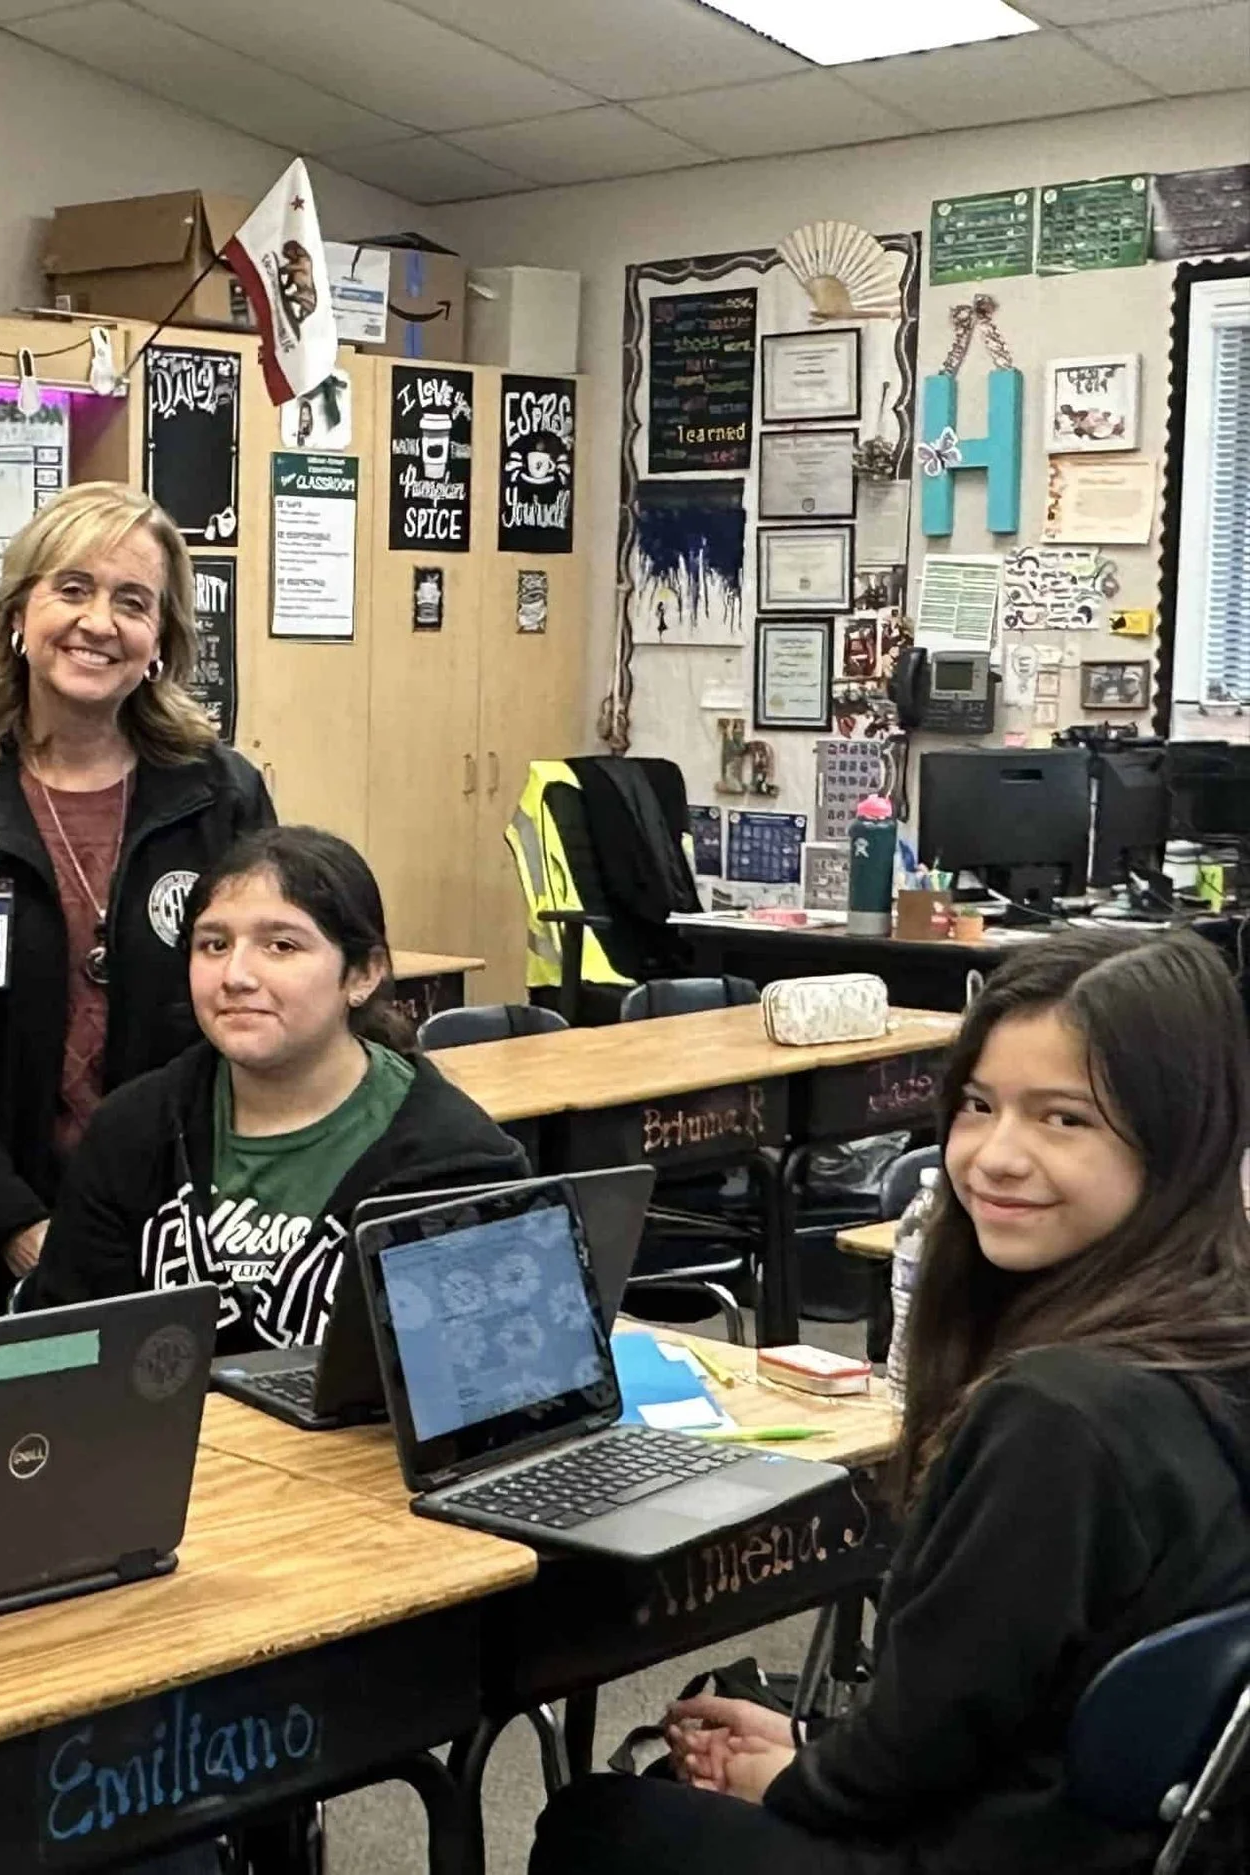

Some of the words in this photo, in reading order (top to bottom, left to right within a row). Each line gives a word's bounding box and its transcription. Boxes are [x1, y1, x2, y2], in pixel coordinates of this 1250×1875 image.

[417, 378, 454, 408] LOVE
[676, 422, 747, 444] learned
[921, 366, 1024, 537] H
[403, 506, 463, 540] SPICE
[13, 1444, 46, 1466] DELL
[47, 1690, 315, 1841] Emiliano
